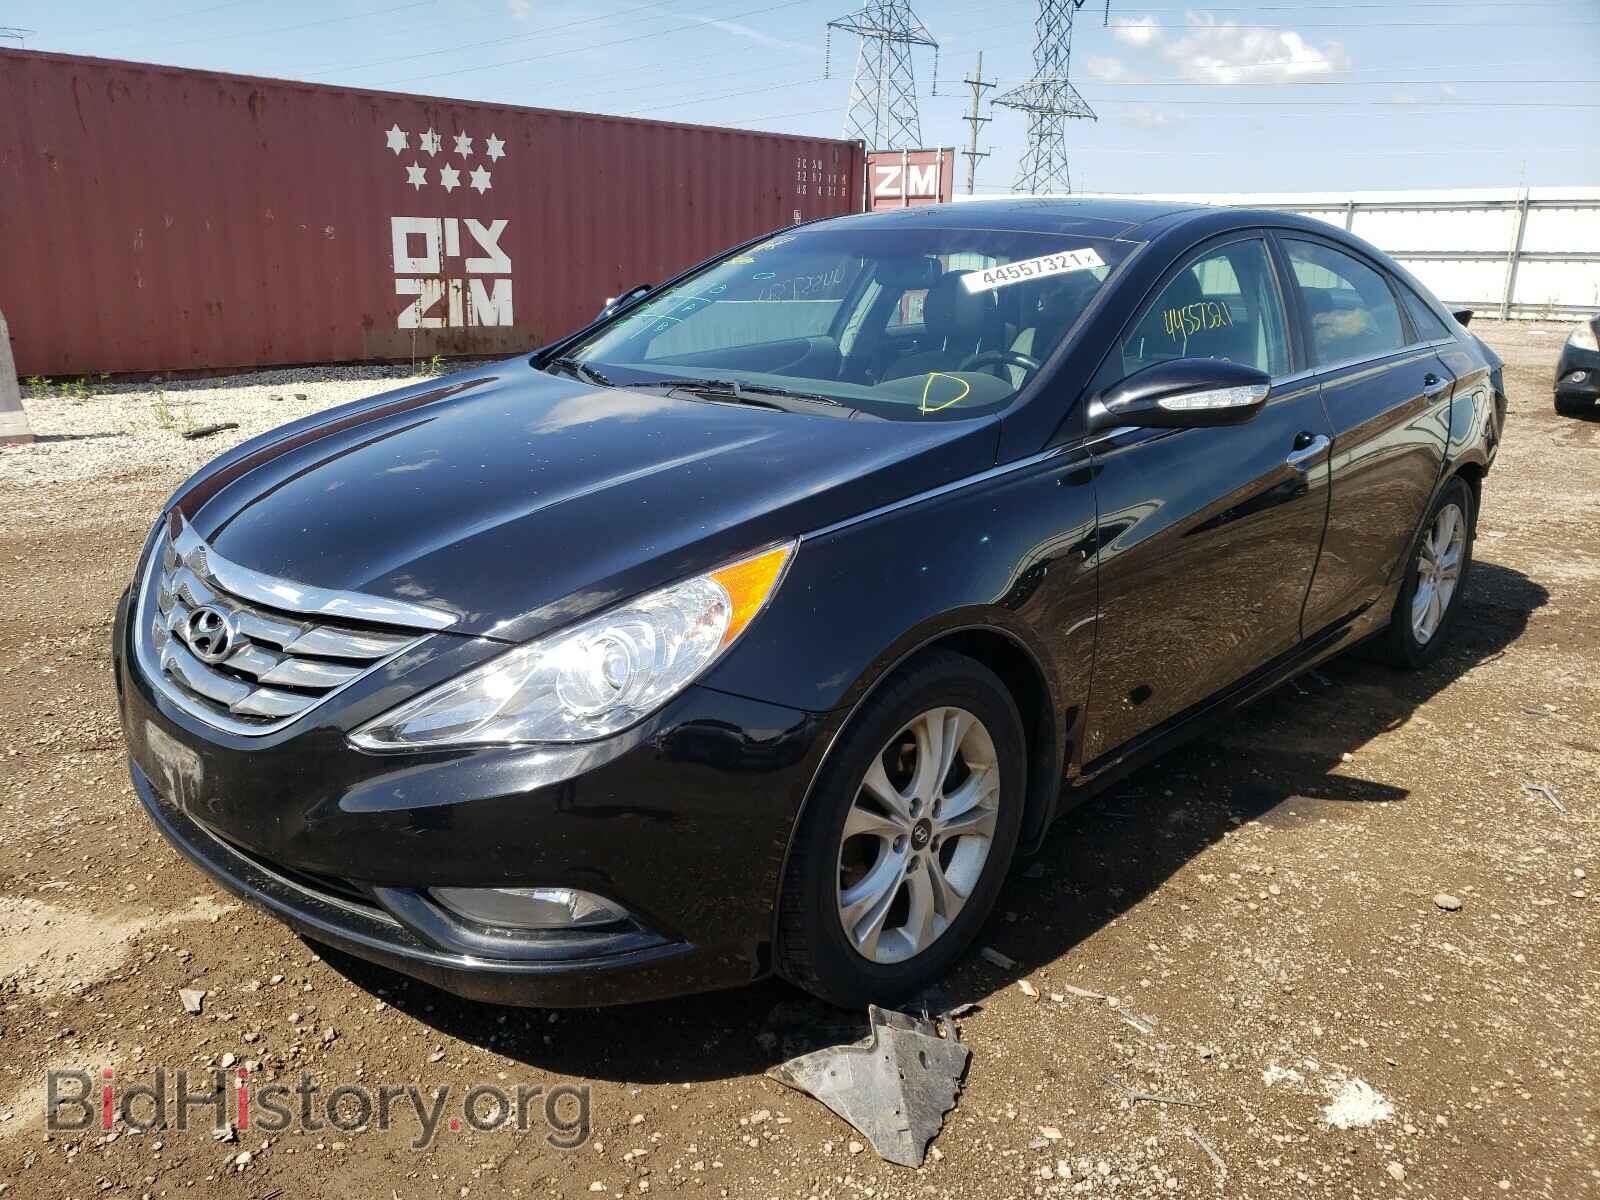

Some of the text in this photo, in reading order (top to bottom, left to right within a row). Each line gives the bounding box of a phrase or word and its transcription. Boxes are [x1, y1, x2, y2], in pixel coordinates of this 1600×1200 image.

[875, 165, 937, 196] ZM
[983, 253, 1082, 284] 44557321
[395, 278, 514, 329] ZIM
[1163, 301, 1233, 341] 44557321
